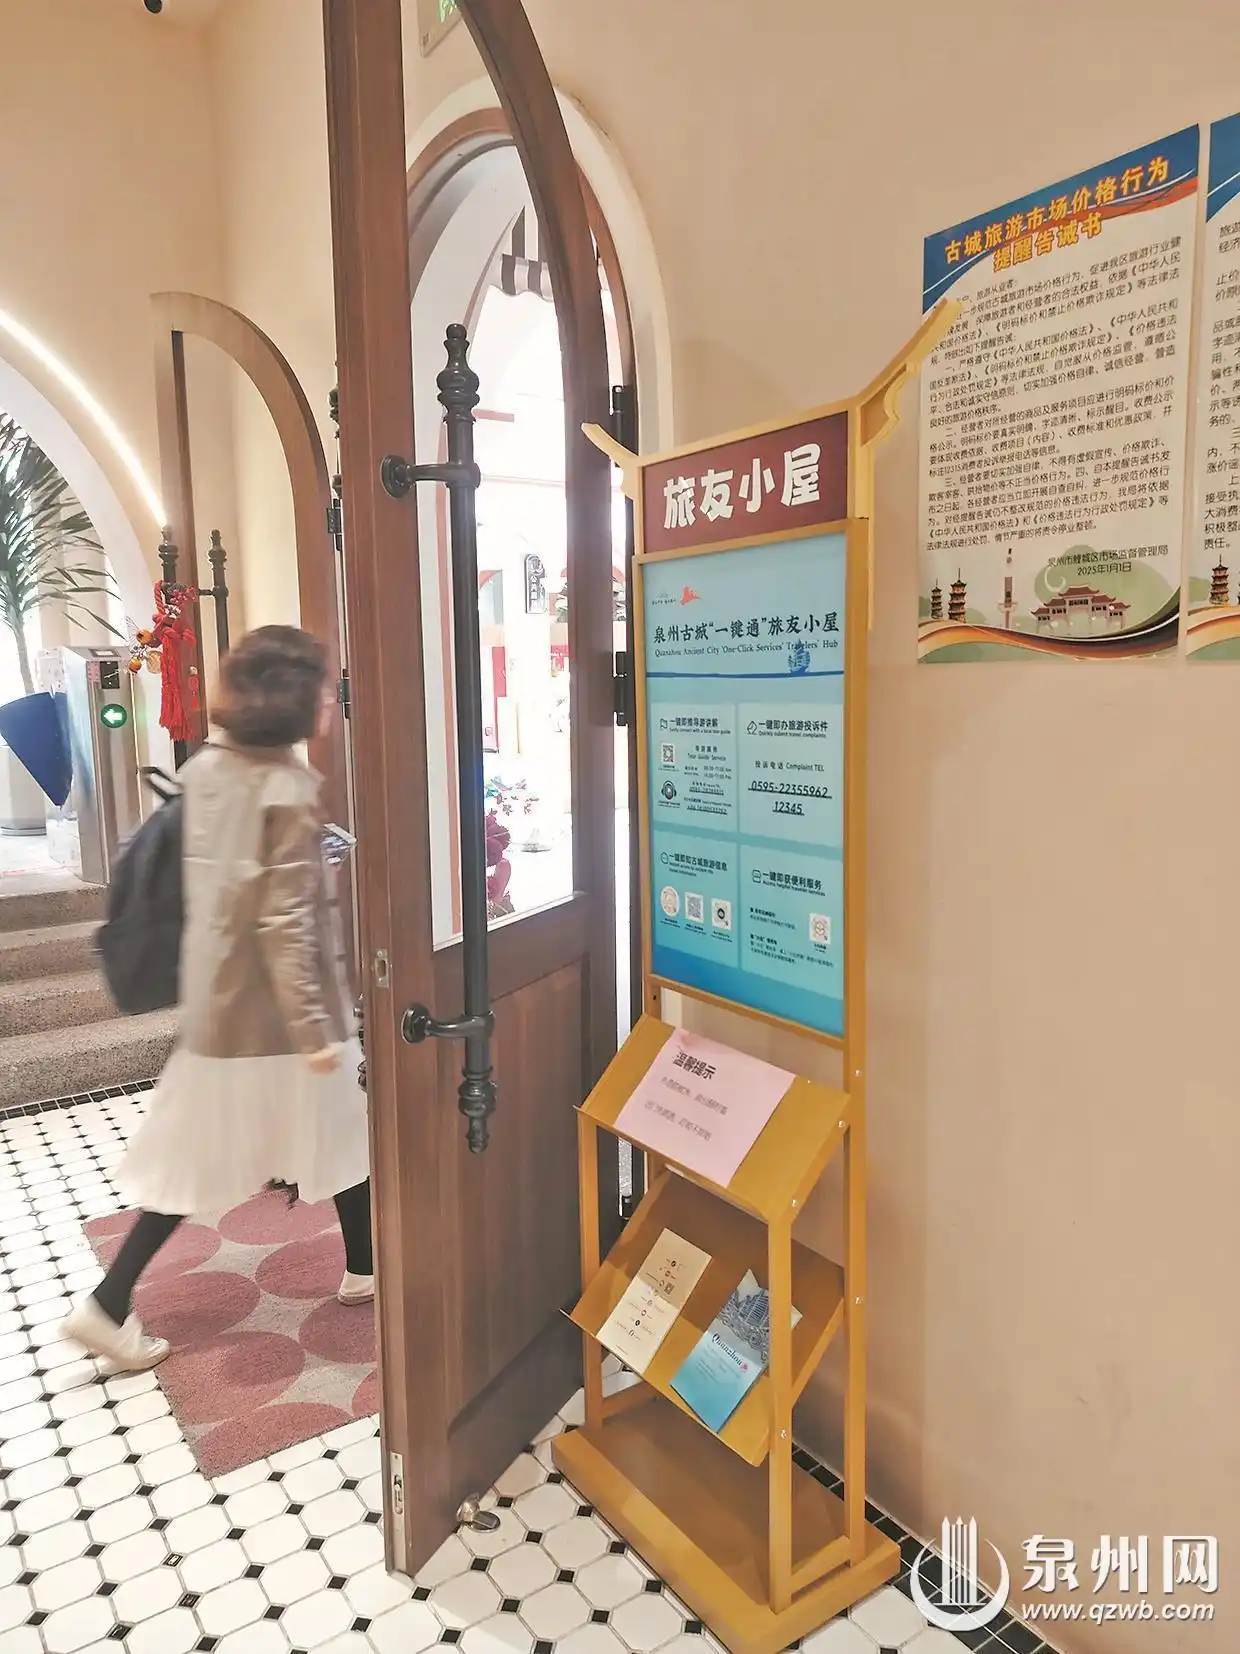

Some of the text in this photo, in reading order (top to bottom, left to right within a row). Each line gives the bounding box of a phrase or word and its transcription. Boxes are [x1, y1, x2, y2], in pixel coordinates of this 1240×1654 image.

[944, 155, 1170, 264] 古城旅游市场价格行为
[993, 211, 1103, 273] 提醒告诫书
[663, 443, 821, 529] 旅友小屋
[1205, 504, 1240, 519] 大消费
[1205, 520, 1240, 534] 积极整
[1077, 561, 1131, 577] 2025年1月1日
[707, 646, 719, 655] City
[822, 640, 838, 648] Hub
[751, 781, 828, 798] 0595-22355962
[774, 801, 802, 814] 12345
[673, 1051, 717, 1080] 温馨提示
